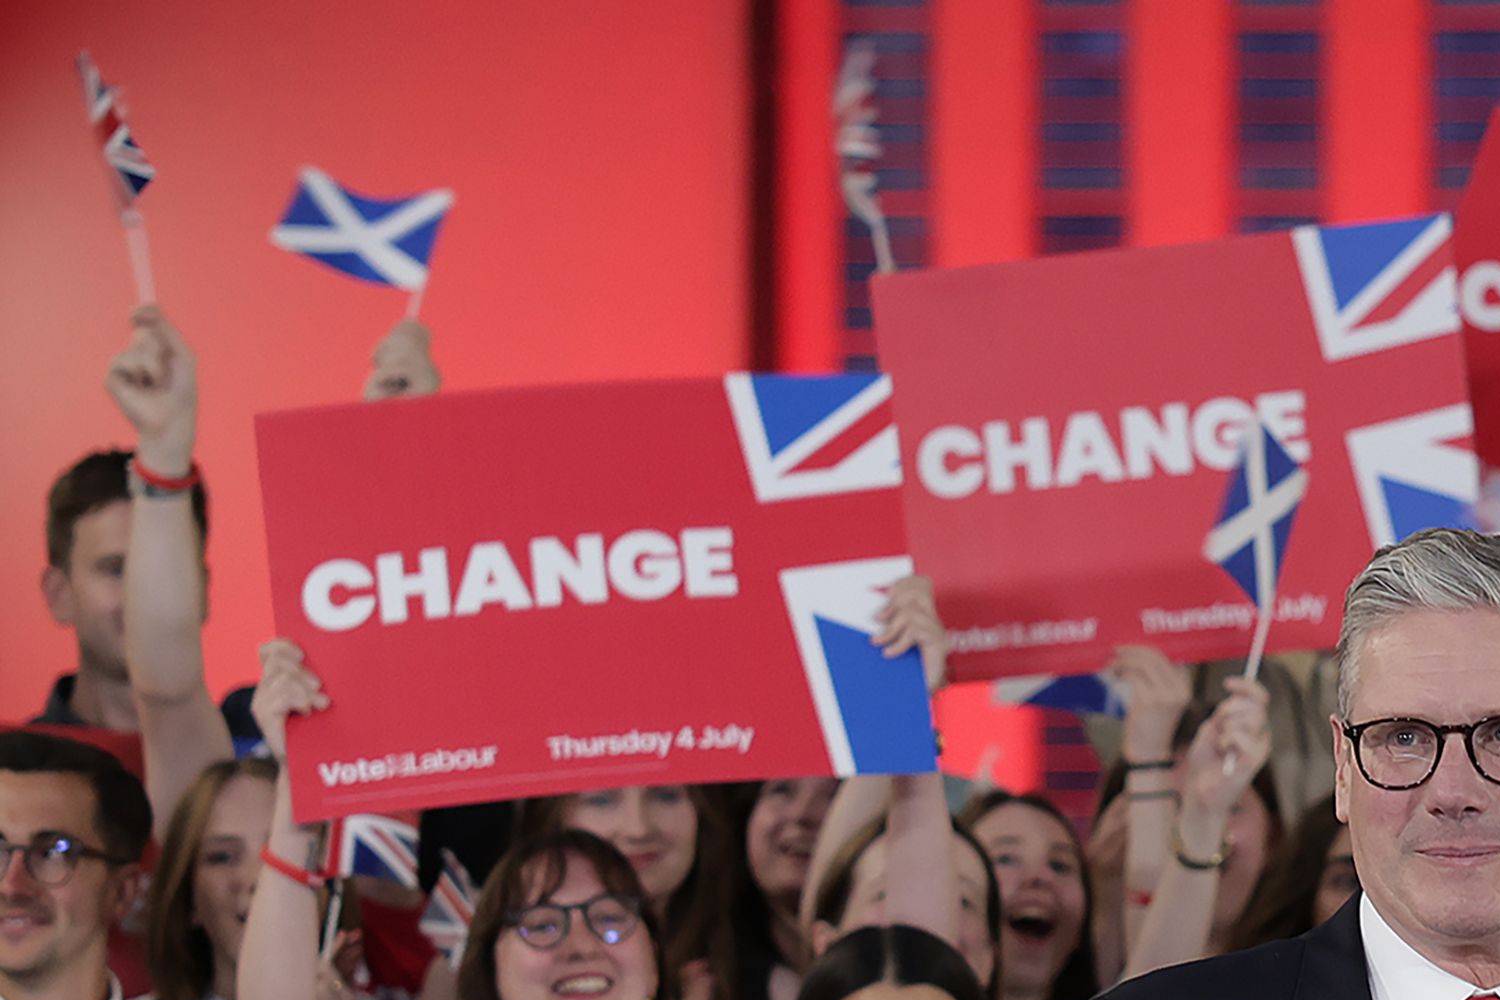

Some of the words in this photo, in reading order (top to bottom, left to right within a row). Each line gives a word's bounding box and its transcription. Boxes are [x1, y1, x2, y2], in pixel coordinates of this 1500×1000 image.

[917, 390, 1310, 498] CHANGE
[302, 527, 738, 631] CHANGE
[318, 758, 387, 787] Vote
[408, 745, 498, 775] Labour
[547, 729, 673, 760] Thursday
[675, 725, 696, 750] 4
[699, 723, 754, 754] July
